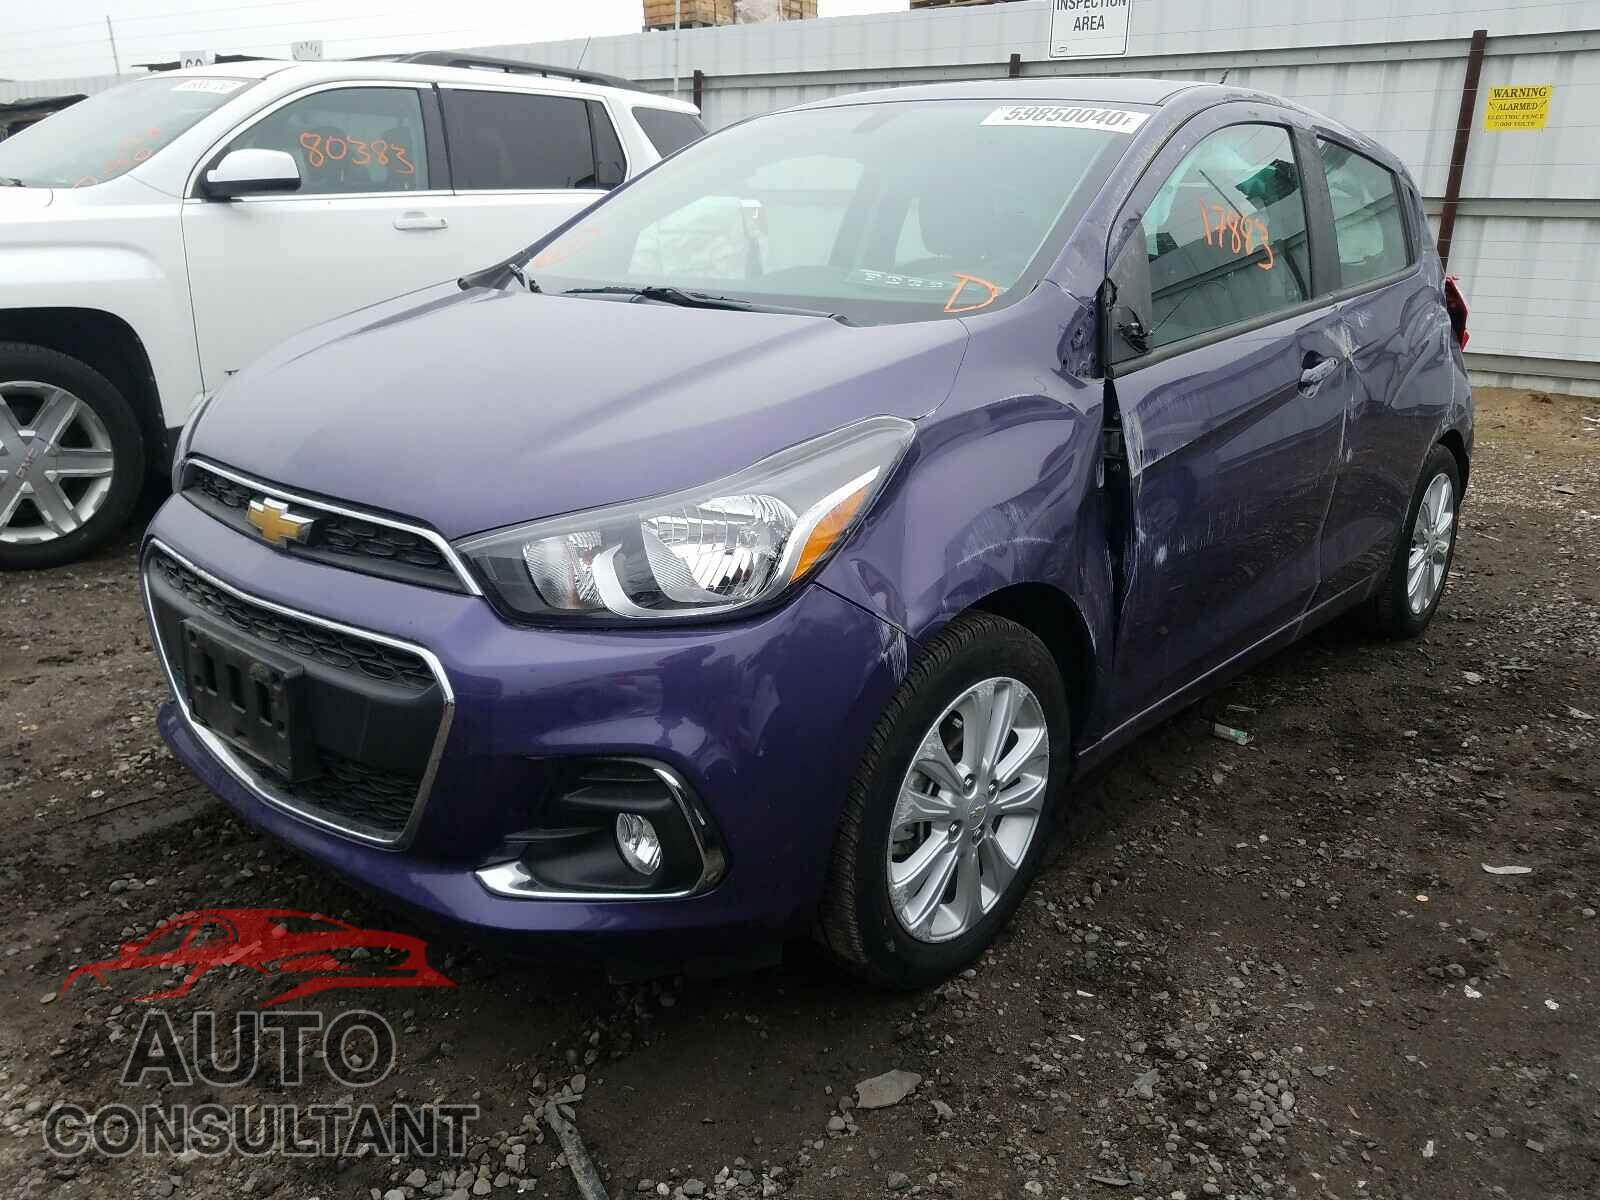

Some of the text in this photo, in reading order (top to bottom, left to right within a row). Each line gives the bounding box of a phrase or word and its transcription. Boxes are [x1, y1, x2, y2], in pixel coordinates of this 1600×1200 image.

[1072, 15, 1105, 31] AREA
[1493, 86, 1547, 98] WARNING
[1497, 102, 1538, 111] ALARMED
[299, 132, 416, 174] 80383
[943, 271, 999, 313] D
